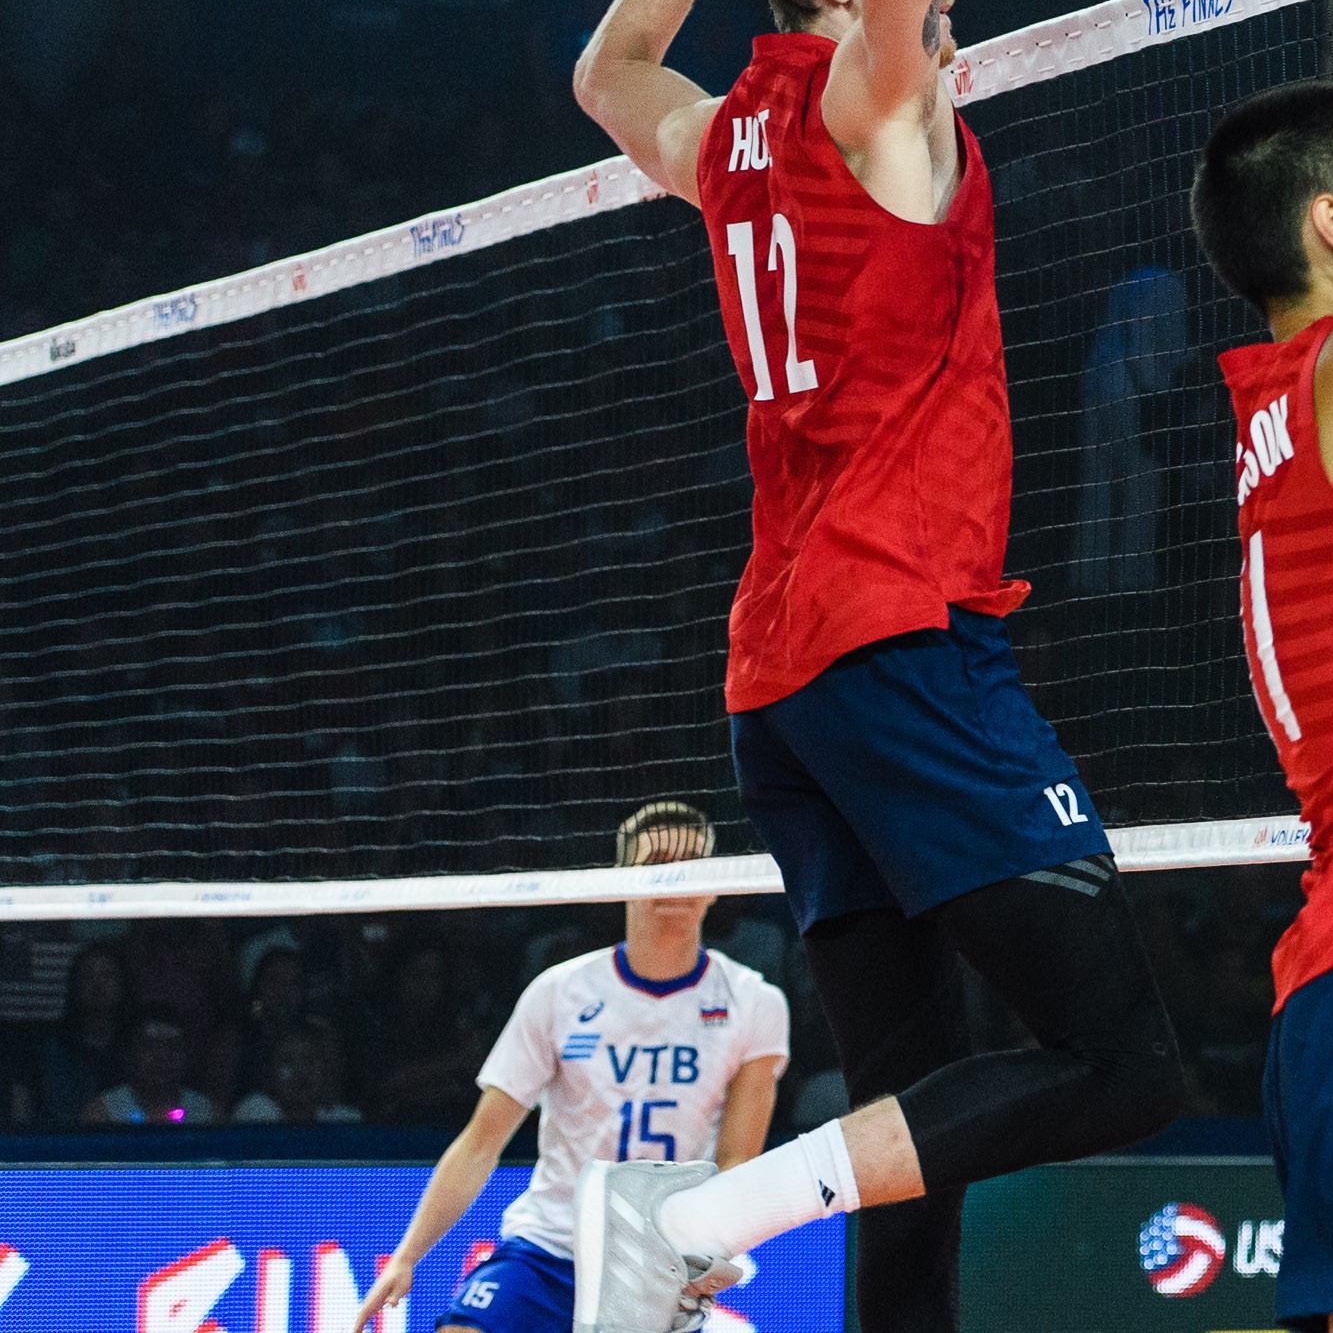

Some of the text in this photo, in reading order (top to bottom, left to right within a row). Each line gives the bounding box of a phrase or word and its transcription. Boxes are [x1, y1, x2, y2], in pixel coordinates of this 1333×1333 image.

[726, 213, 819, 401] 12
[1044, 783, 1088, 827] 12
[608, 1045, 701, 1084] VTB
[615, 1101, 677, 1162] 15
[462, 1279, 500, 1311] 15
